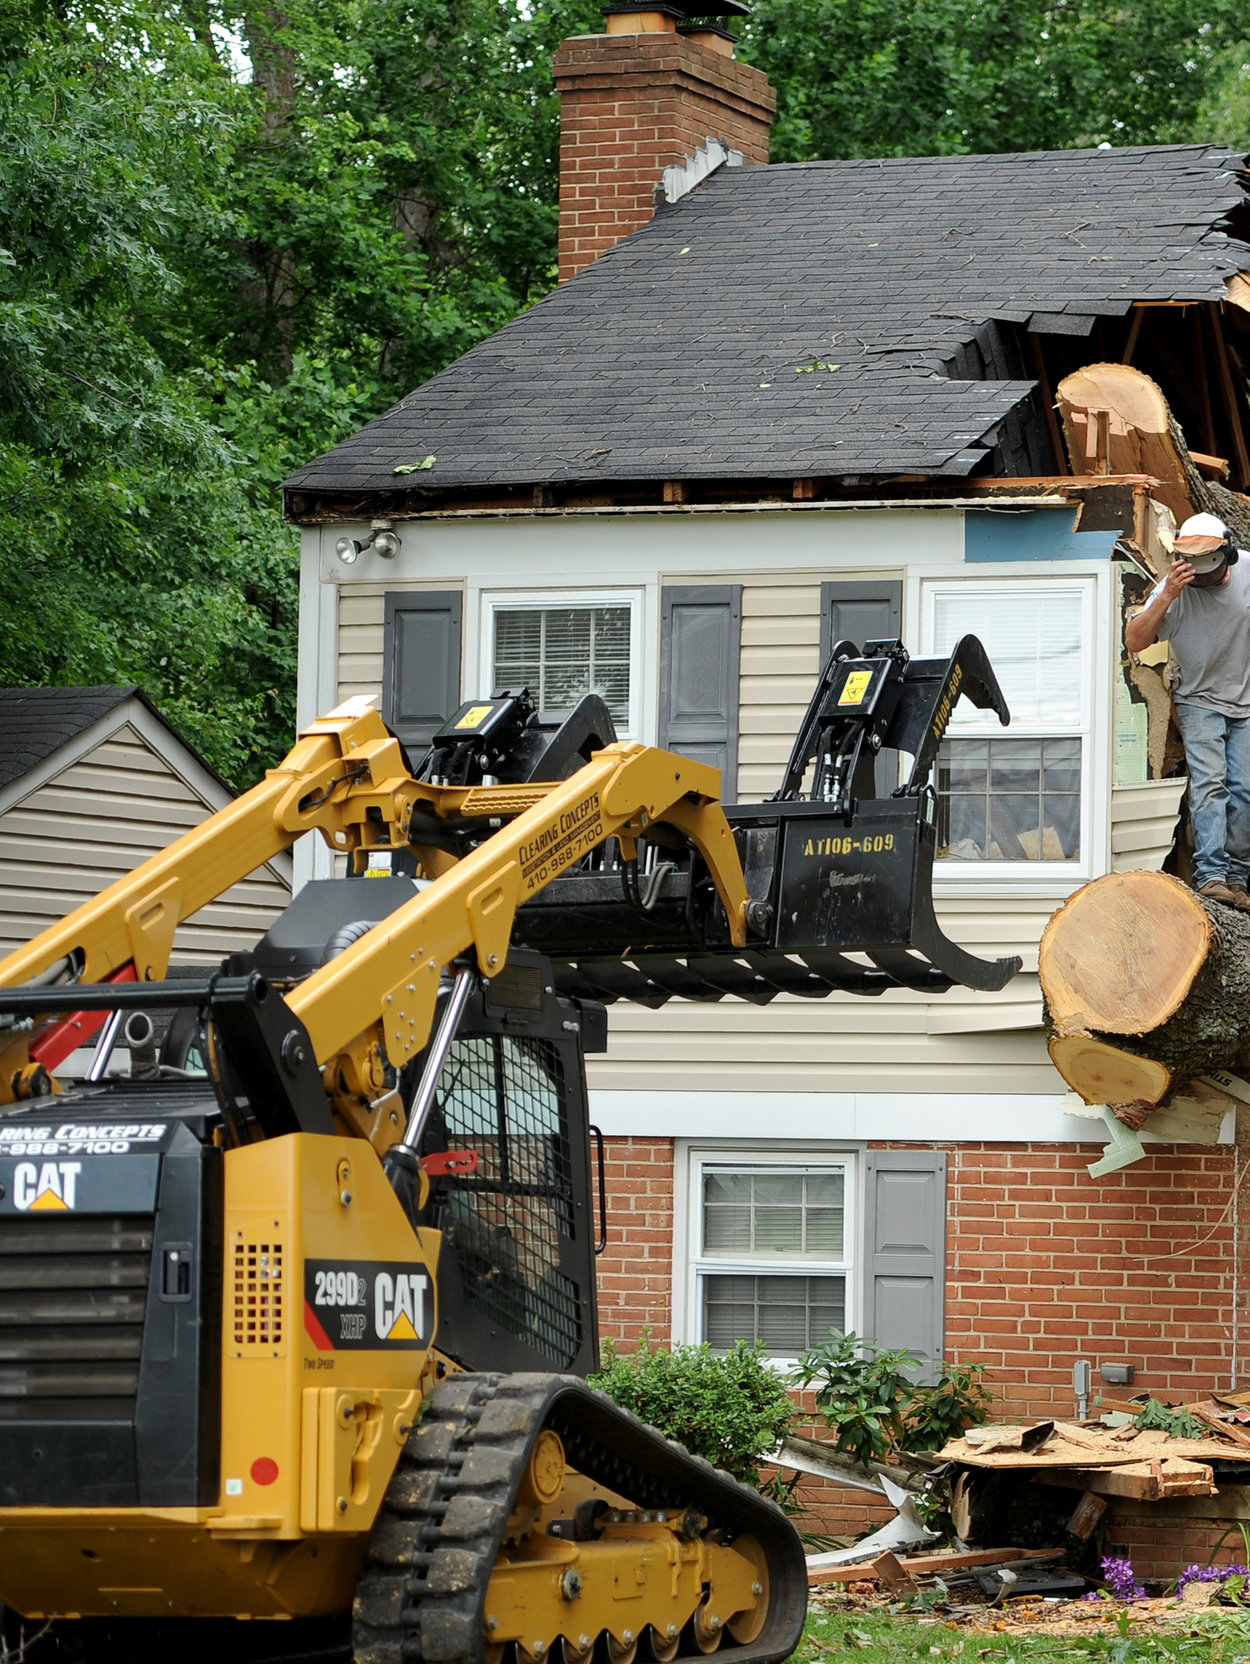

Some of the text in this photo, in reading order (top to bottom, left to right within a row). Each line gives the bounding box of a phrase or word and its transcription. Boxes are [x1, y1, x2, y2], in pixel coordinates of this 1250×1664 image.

[519, 792, 599, 865] CLEARING CONCEPTS
[527, 823, 603, 889] 410-988-7100
[0, 1141, 130, 1156] -988-7100
[54, 1123, 168, 1140] CONCEPTS
[13, 1161, 82, 1211] CAT
[340, 1313, 367, 1340] XHP
[374, 1272, 428, 1340] CAT
